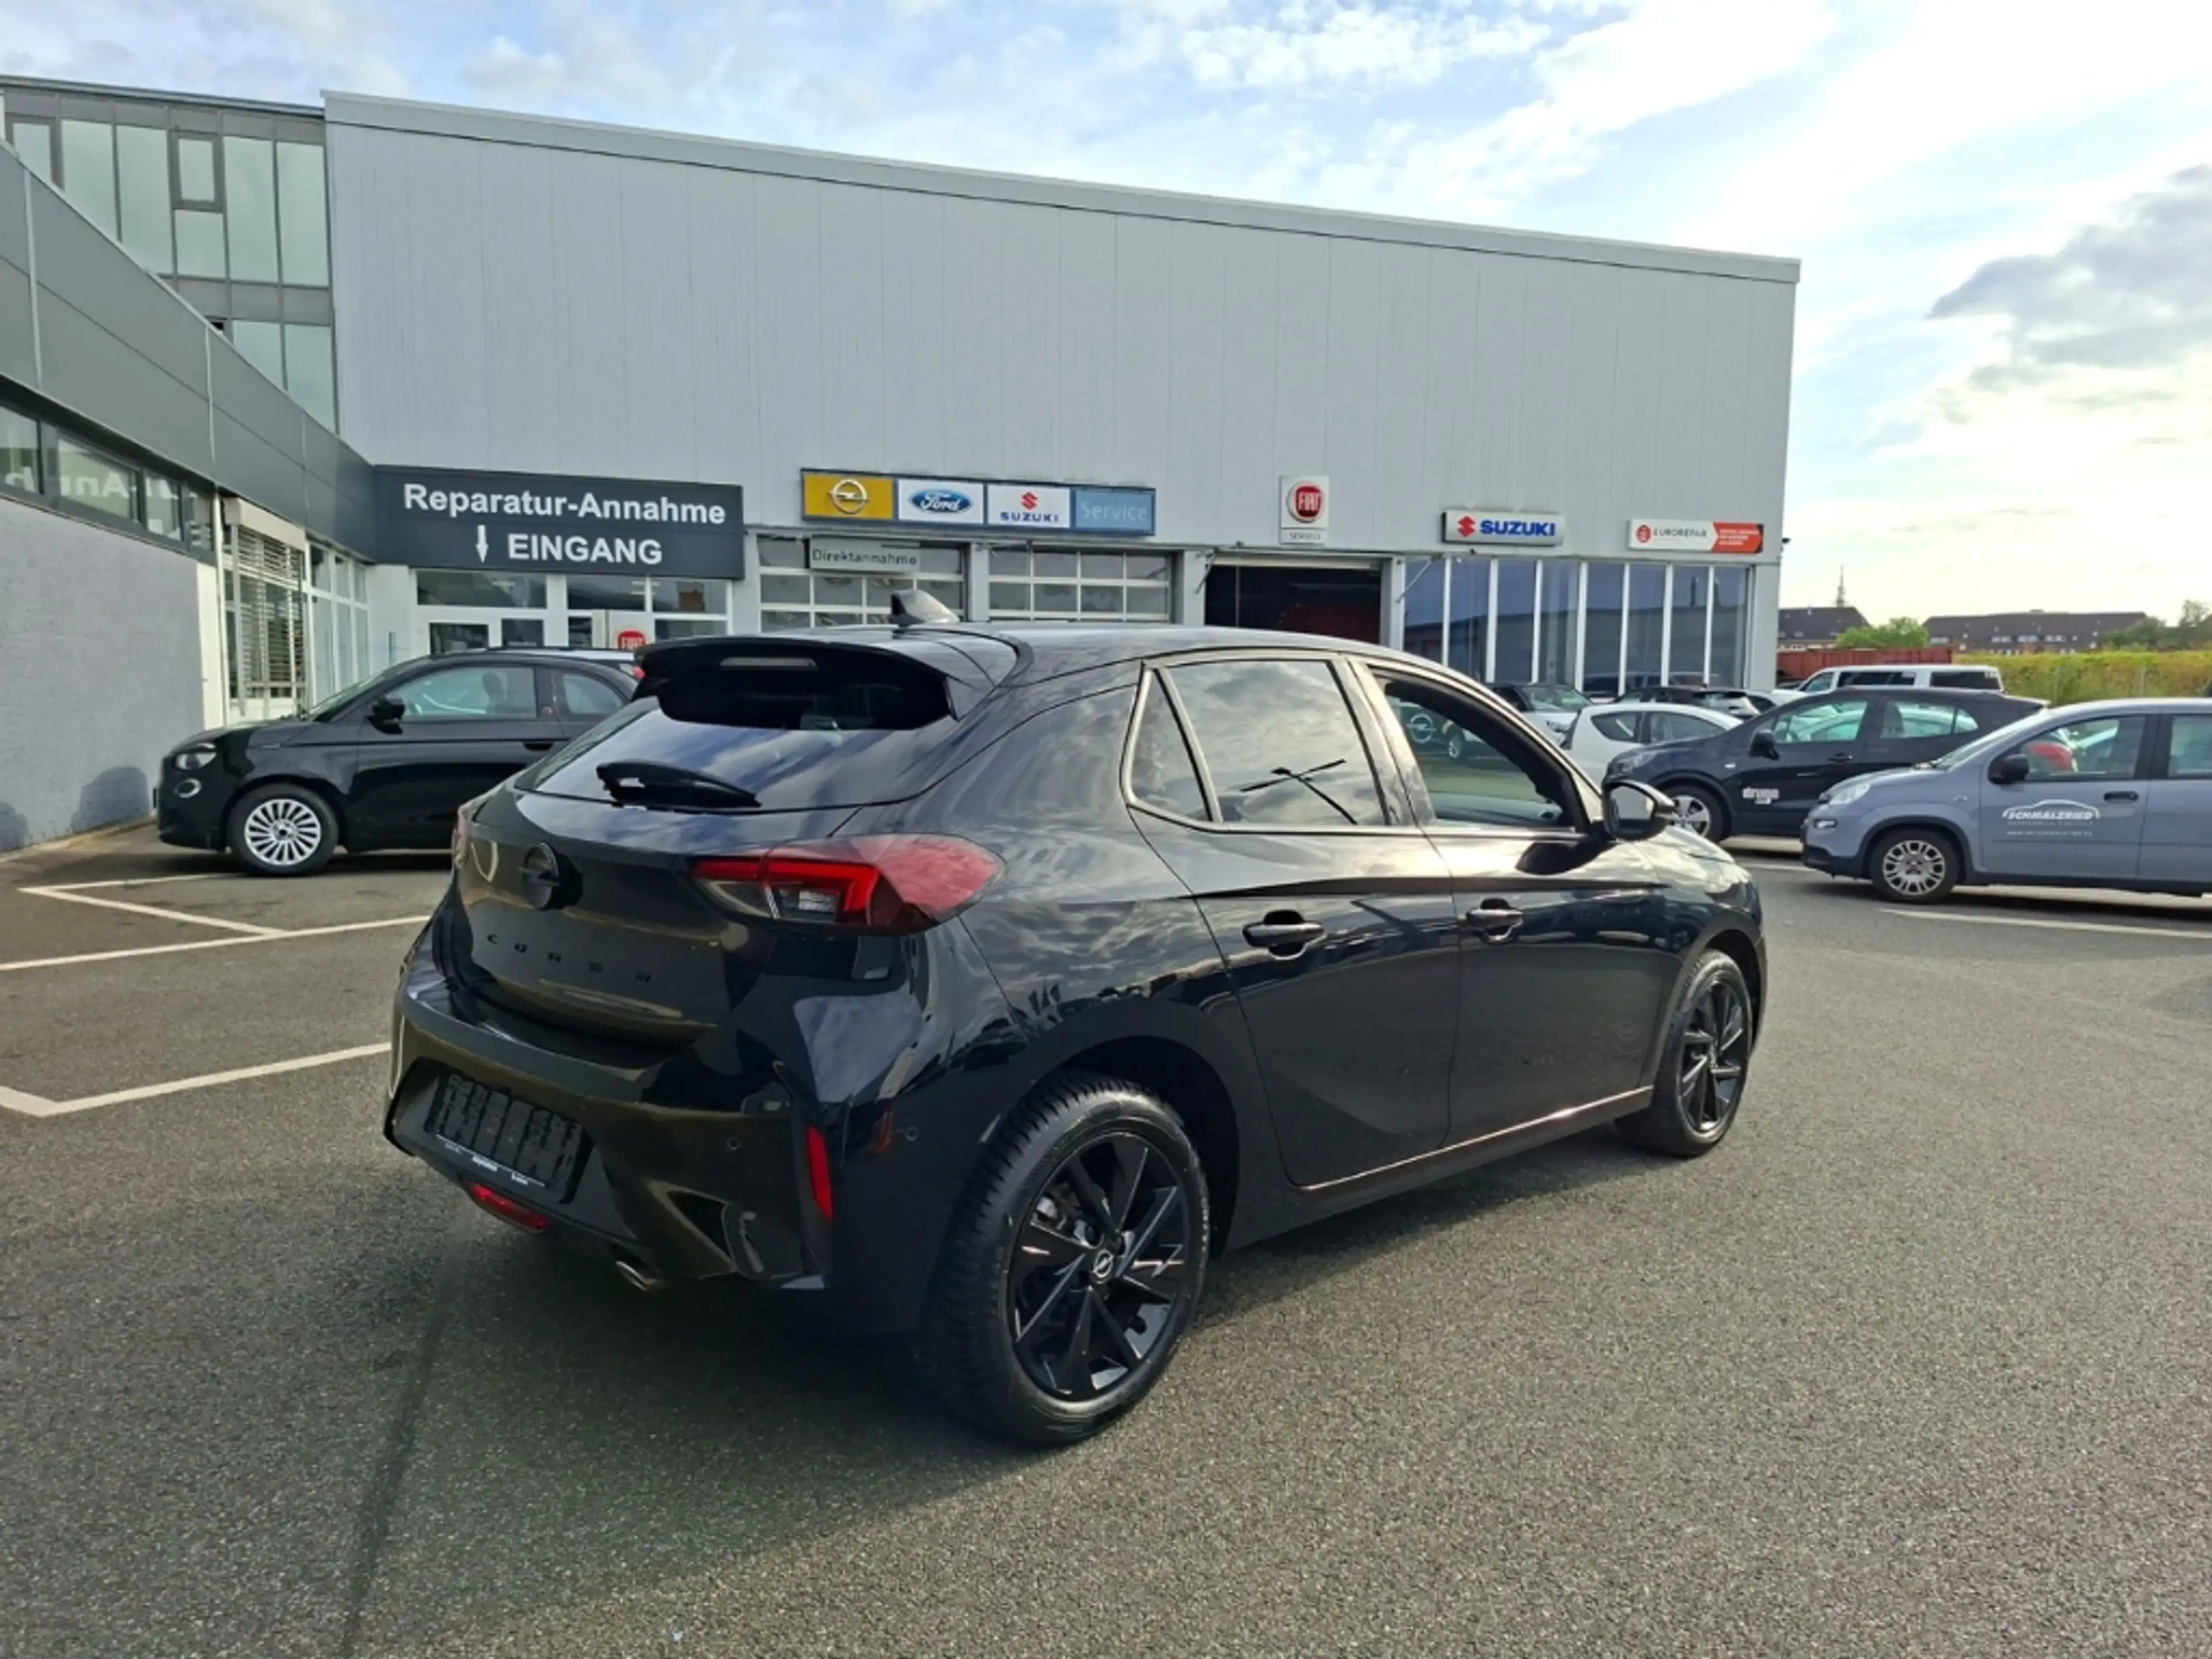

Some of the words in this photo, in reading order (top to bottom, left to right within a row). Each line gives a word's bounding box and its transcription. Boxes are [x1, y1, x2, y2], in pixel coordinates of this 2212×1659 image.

[404, 483, 726, 524] Reparatur-Annahme
[919, 494, 961, 513] Ford
[1081, 501, 1147, 521] Service
[1298, 492, 1319, 512] FIAT
[1001, 511, 1059, 523] SUZUKI
[1480, 520, 1555, 536] SUZUKI
[507, 533, 662, 565] EINGANG
[812, 549, 917, 565] Direktannahme
